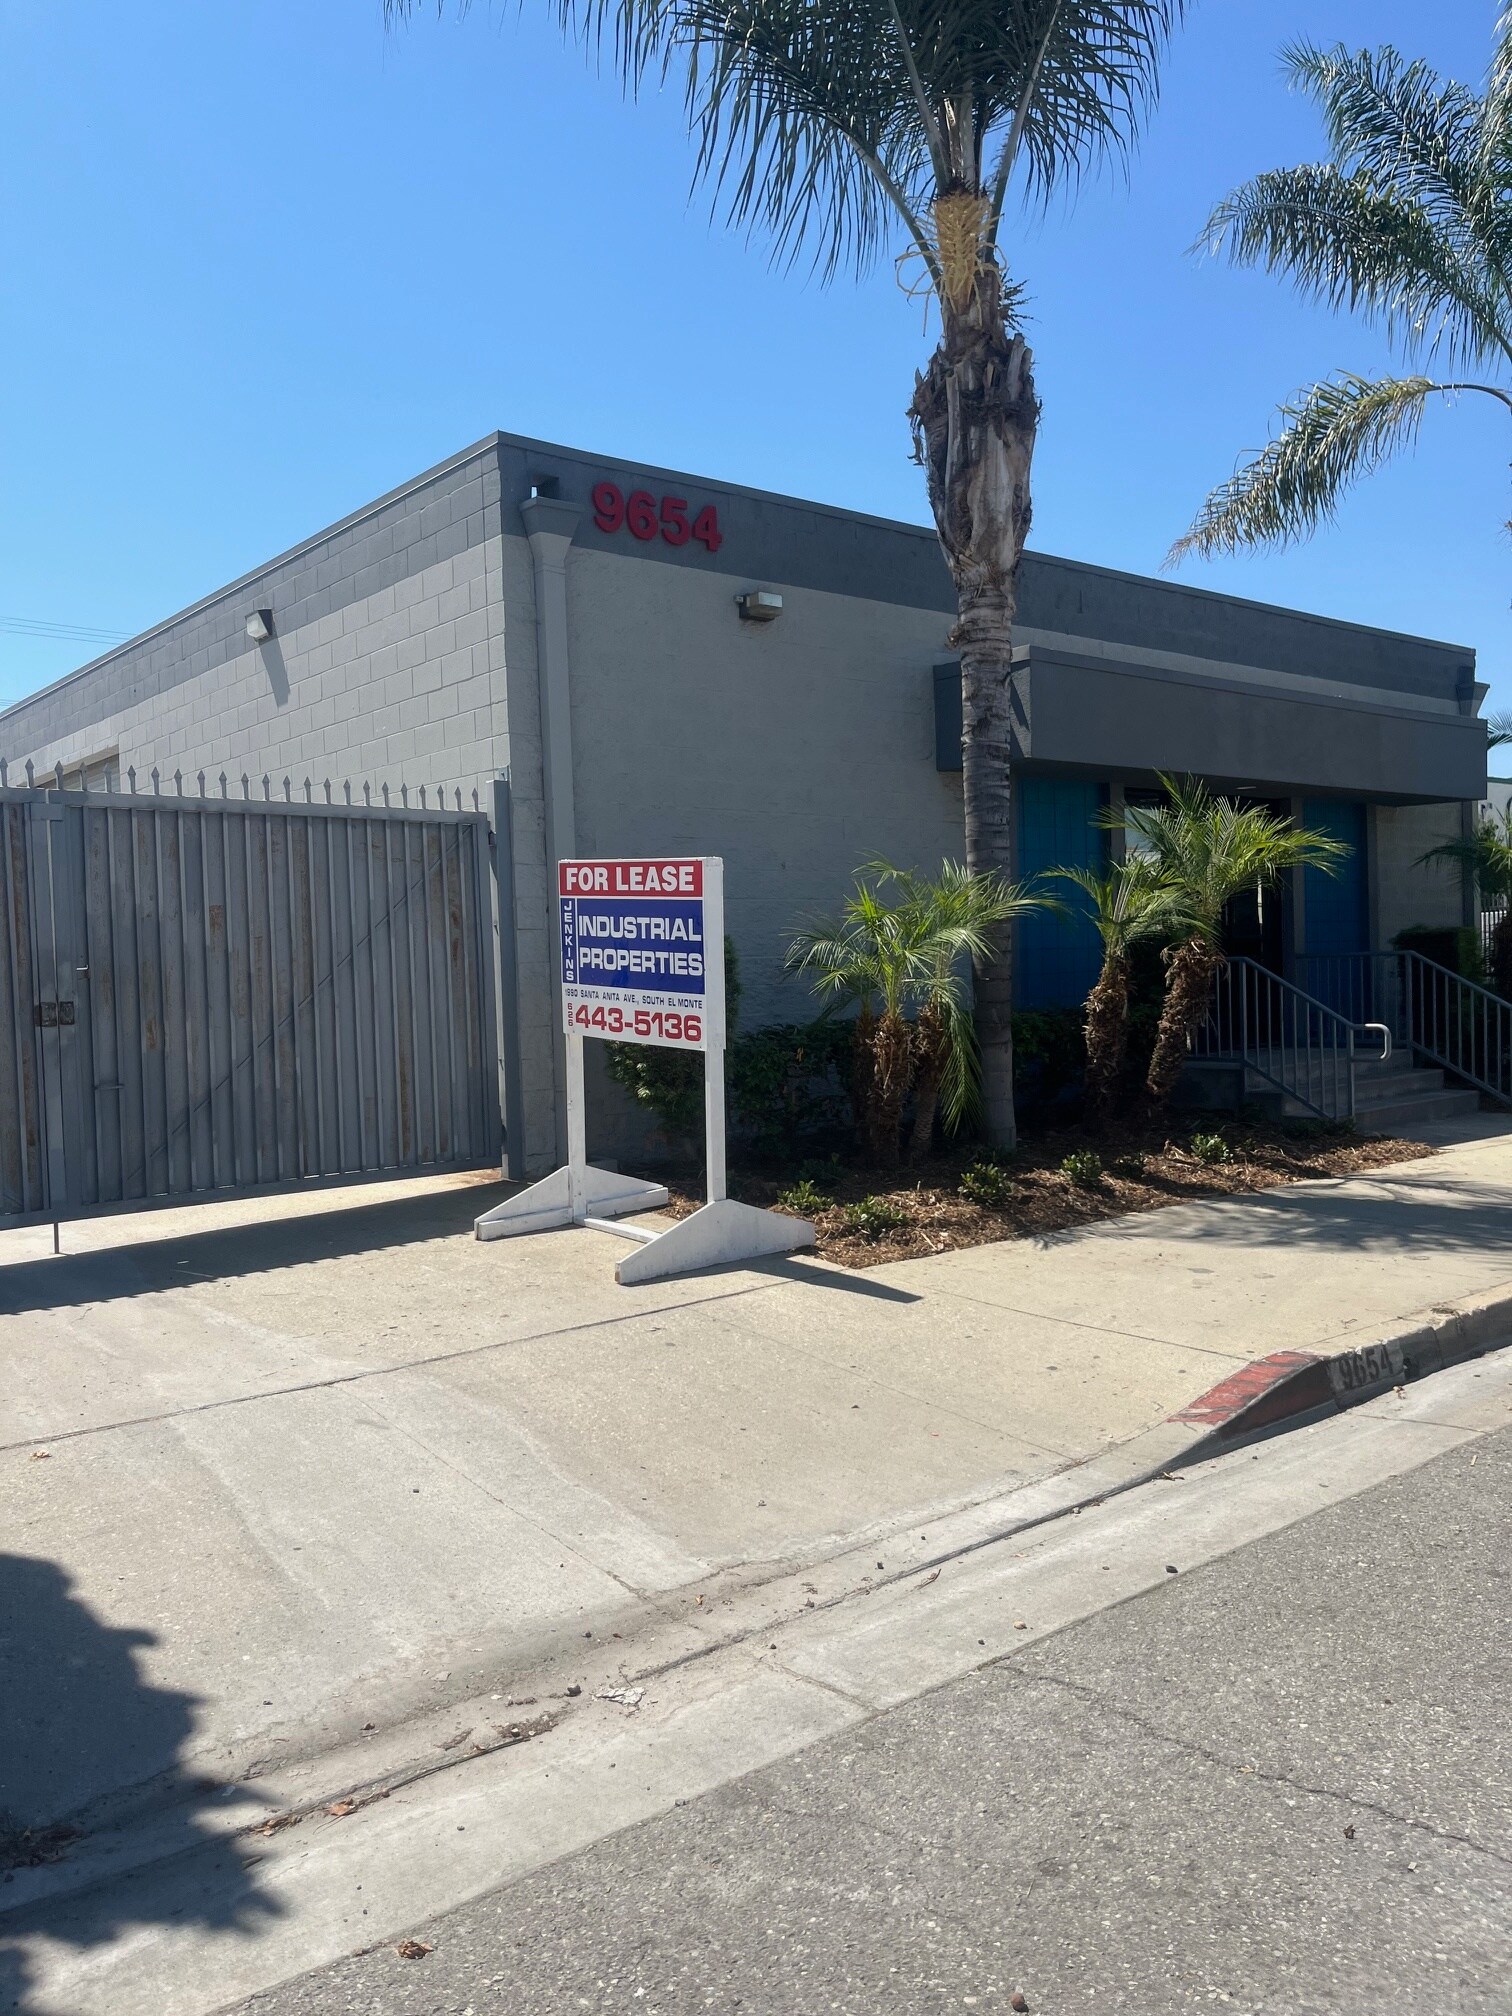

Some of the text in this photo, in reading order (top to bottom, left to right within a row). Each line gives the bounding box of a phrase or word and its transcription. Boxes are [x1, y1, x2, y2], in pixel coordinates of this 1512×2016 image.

[592, 482, 723, 552] 9654
[566, 865, 694, 892] FOR LEASE
[564, 901, 574, 980] JENKINS
[579, 915, 702, 941] INDUSTRIAL
[580, 947, 703, 976] PROPERTIES
[580, 989, 600, 999] SANTA
[602, 991, 620, 1001] ANITA
[642, 995, 665, 1006] SOUTH
[668, 997, 676, 1007] EL
[677, 998, 703, 1009] MONTE
[575, 1004, 702, 1042] 443-5136
[1338, 1345, 1394, 1391] 9654
